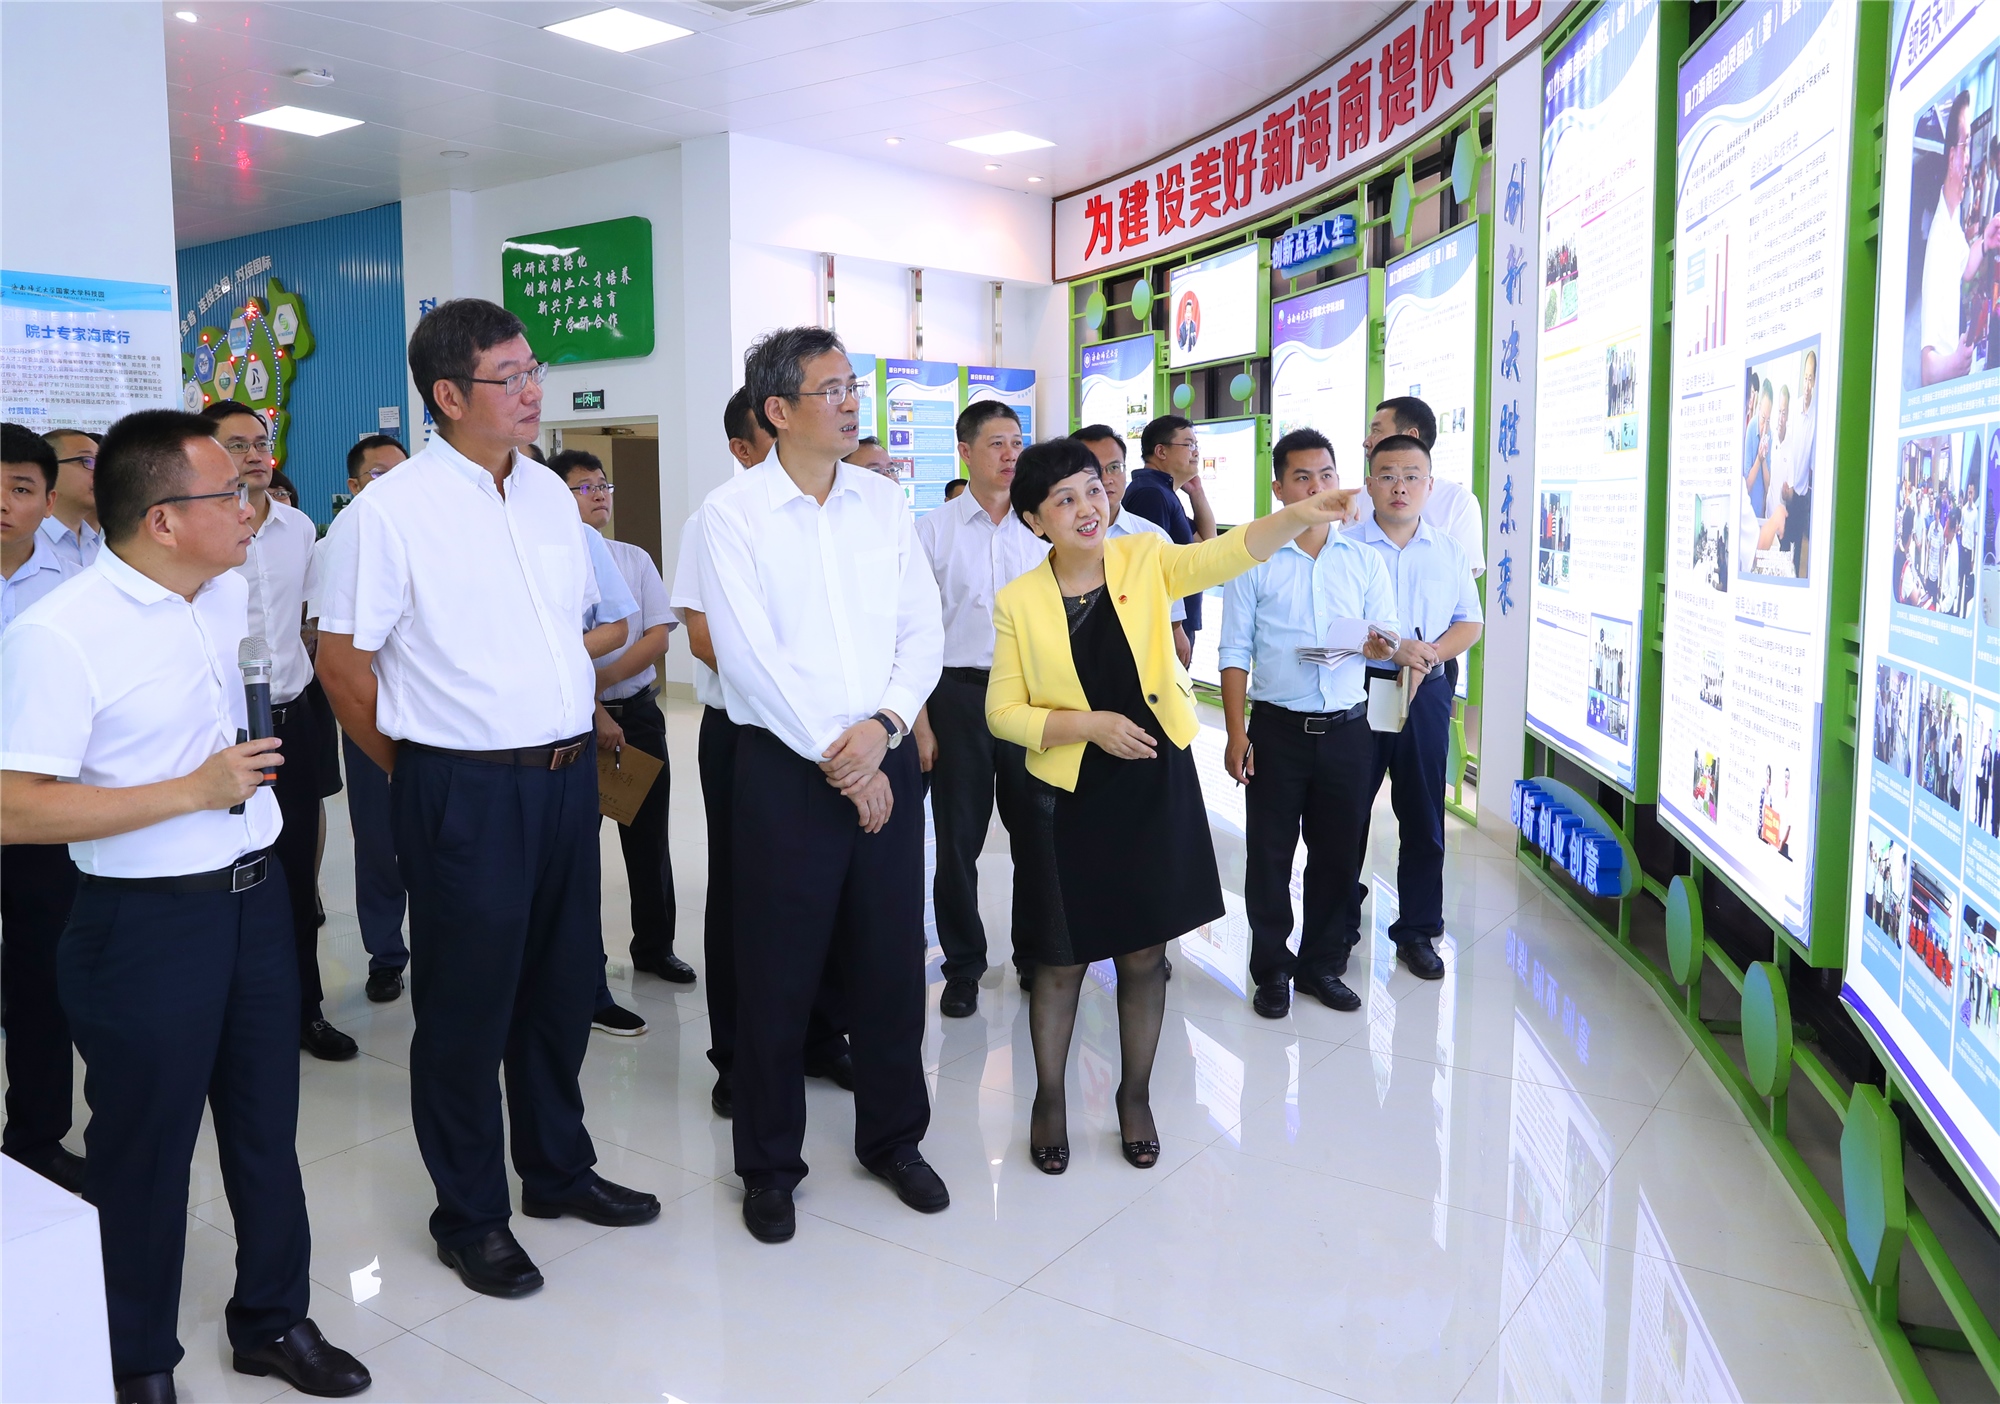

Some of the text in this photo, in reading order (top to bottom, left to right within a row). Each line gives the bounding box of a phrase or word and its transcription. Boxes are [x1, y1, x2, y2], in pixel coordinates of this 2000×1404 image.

[1271, 215, 1346, 269] 创新点亮人生
[512, 254, 587, 279] 科研成果转化
[11, 283, 105, 298] 海南师范大学国家大学科技园
[524, 265, 632, 297] 创新创业人才培养
[180, 310, 197, 342] 全省
[235, 255, 272, 283] 对接国际
[537, 290, 617, 316] 新兴产业培育
[25, 323, 131, 344] 院士专家海南行
[552, 312, 619, 336] 产学研合作
[1510, 780, 1606, 897] 创新创业创意
